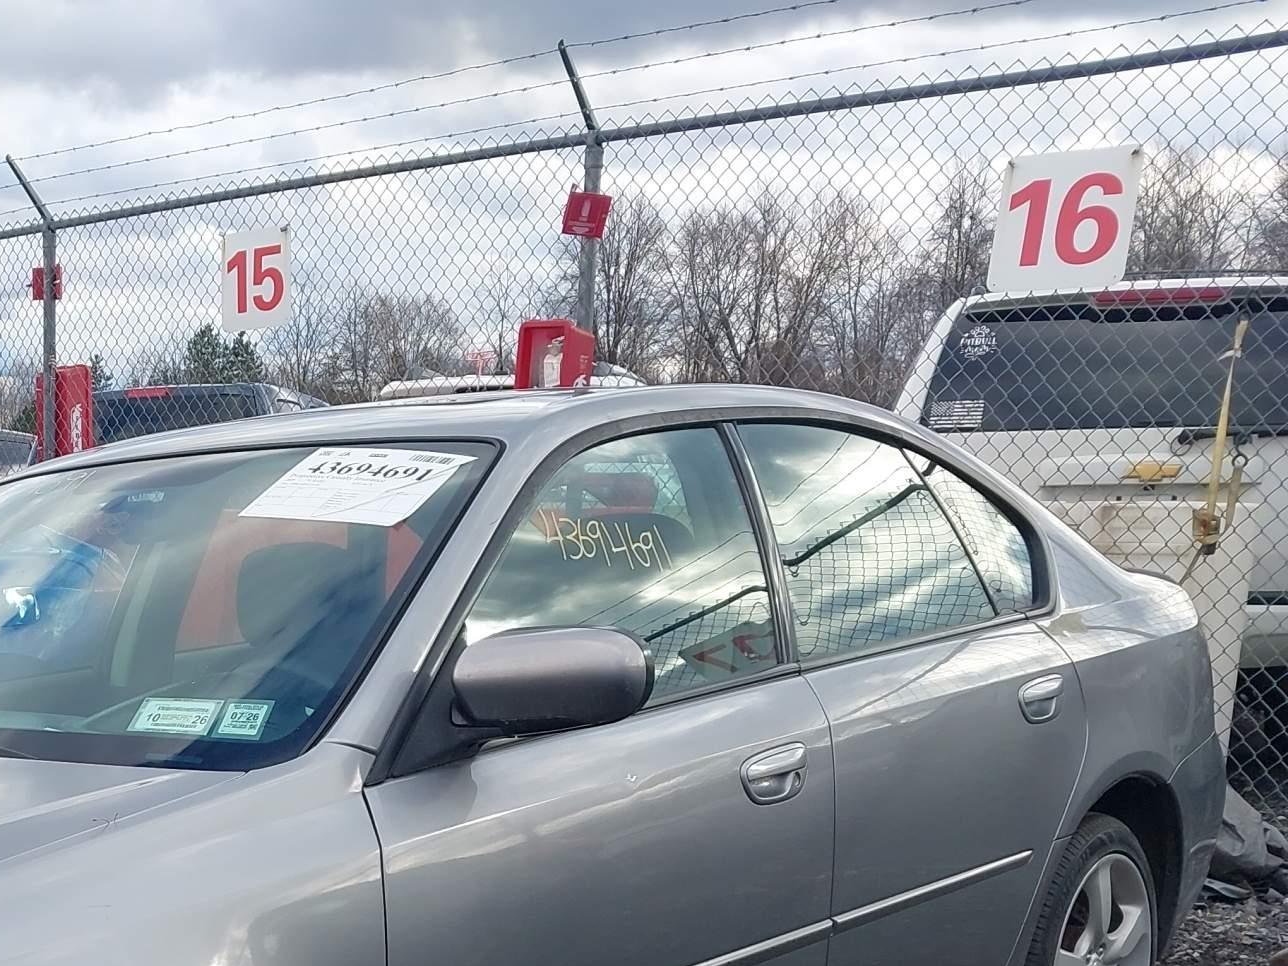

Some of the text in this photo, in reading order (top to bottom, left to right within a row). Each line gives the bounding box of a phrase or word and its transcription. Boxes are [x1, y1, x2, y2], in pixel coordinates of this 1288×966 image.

[1008, 171, 1125, 267] 16
[226, 244, 285, 314] 15
[309, 460, 434, 482] 43694691
[538, 508, 673, 572] 43694691
[191, 715, 209, 725] 26
